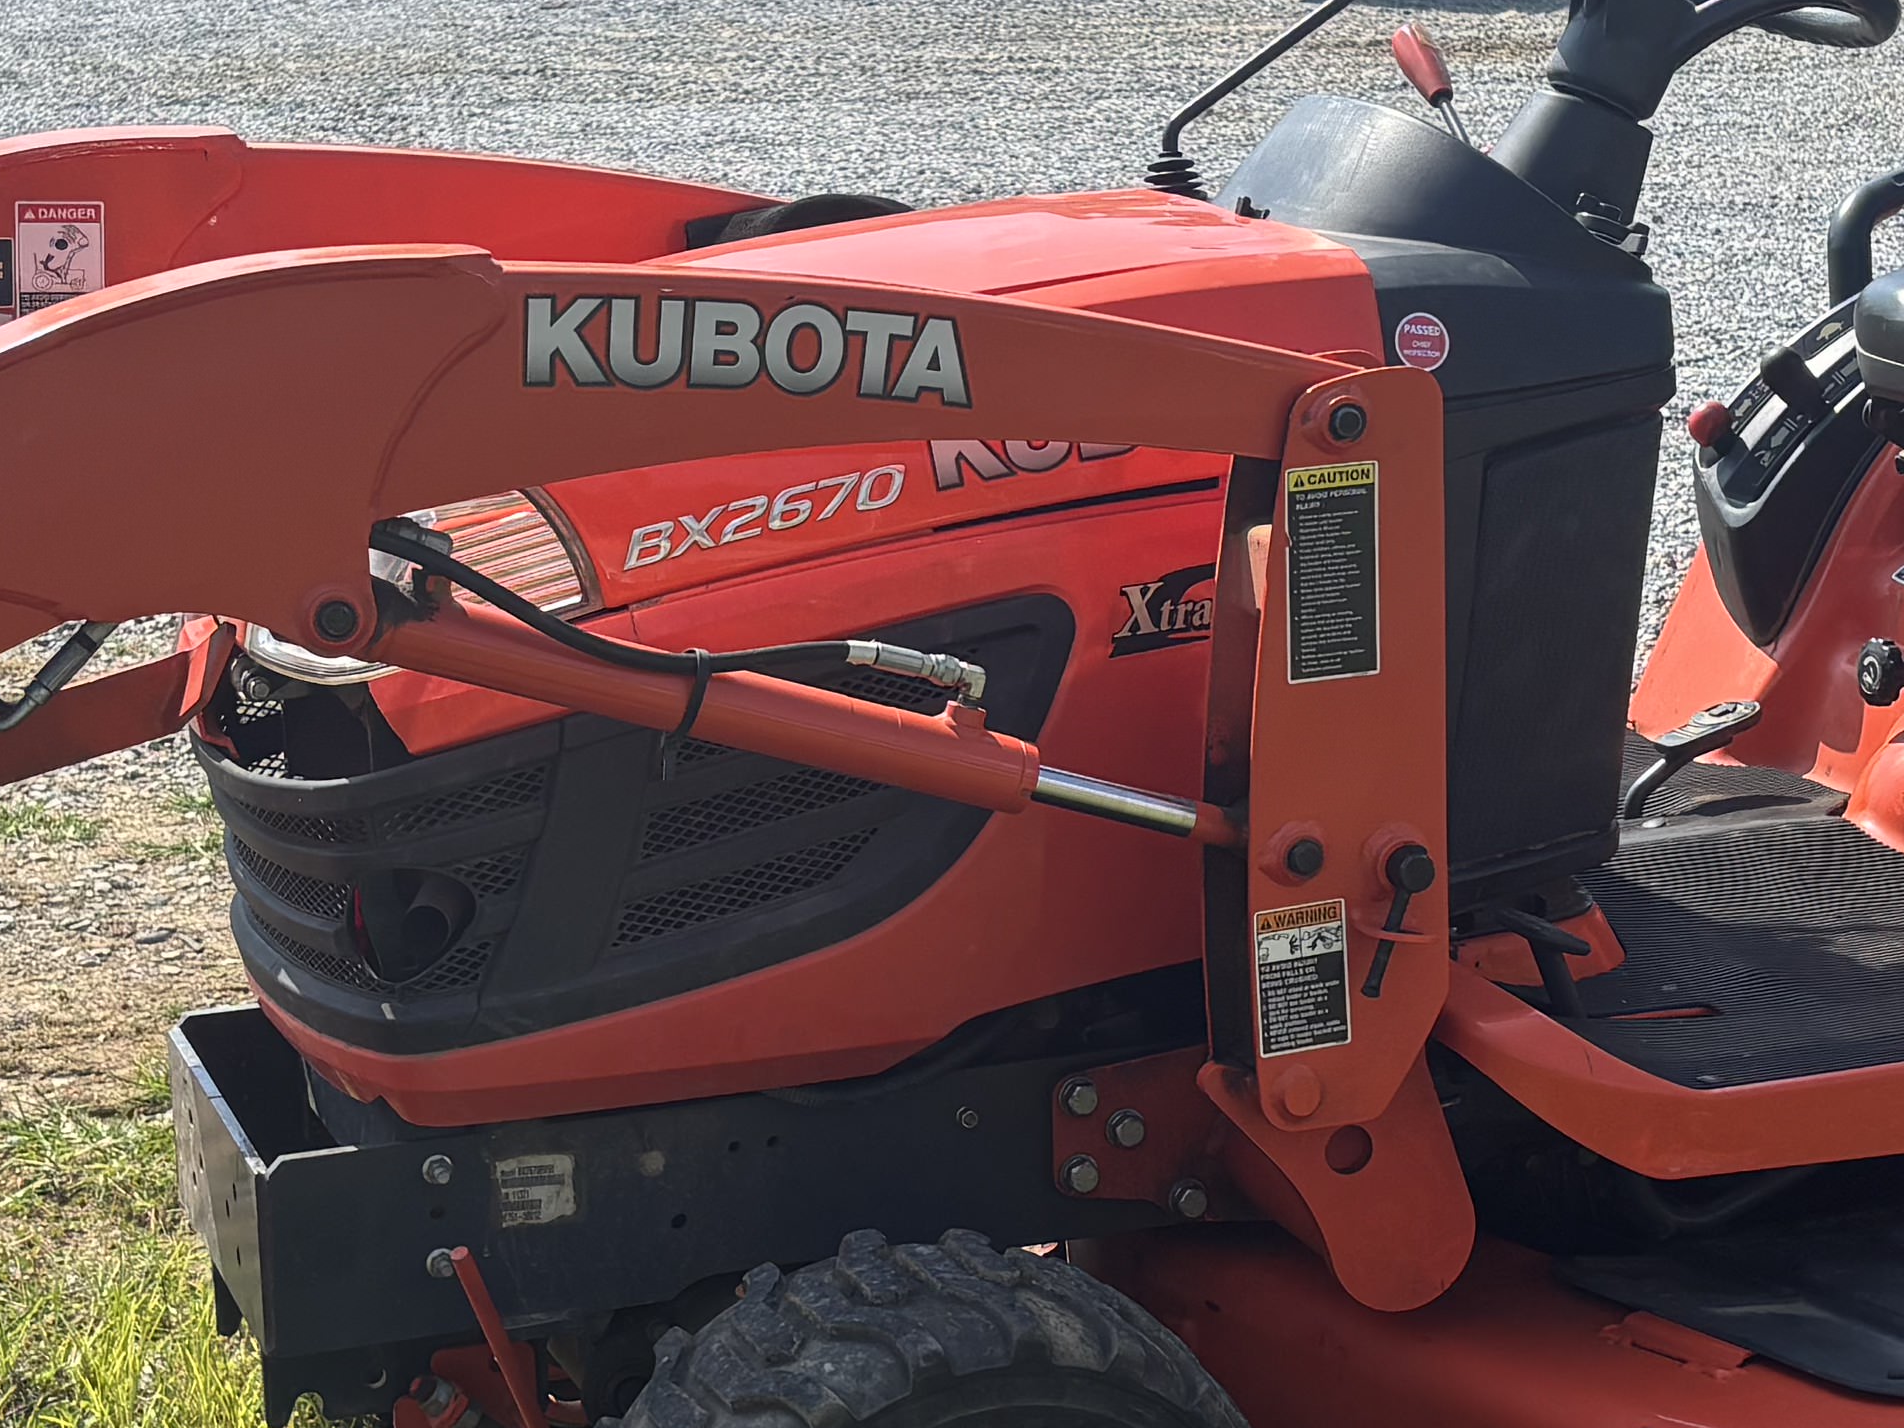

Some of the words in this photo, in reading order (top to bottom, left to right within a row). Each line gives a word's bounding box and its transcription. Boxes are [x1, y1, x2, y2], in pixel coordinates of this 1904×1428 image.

[38, 208, 95, 219] DANGER
[1403, 324, 1440, 336] PASSED
[524, 295, 972, 408] KUBOTA
[1307, 468, 1370, 485] CAUTION
[622, 463, 906, 571] BX2670
[1113, 581, 1212, 638] Xtra
[1274, 906, 1336, 927] WARNING
